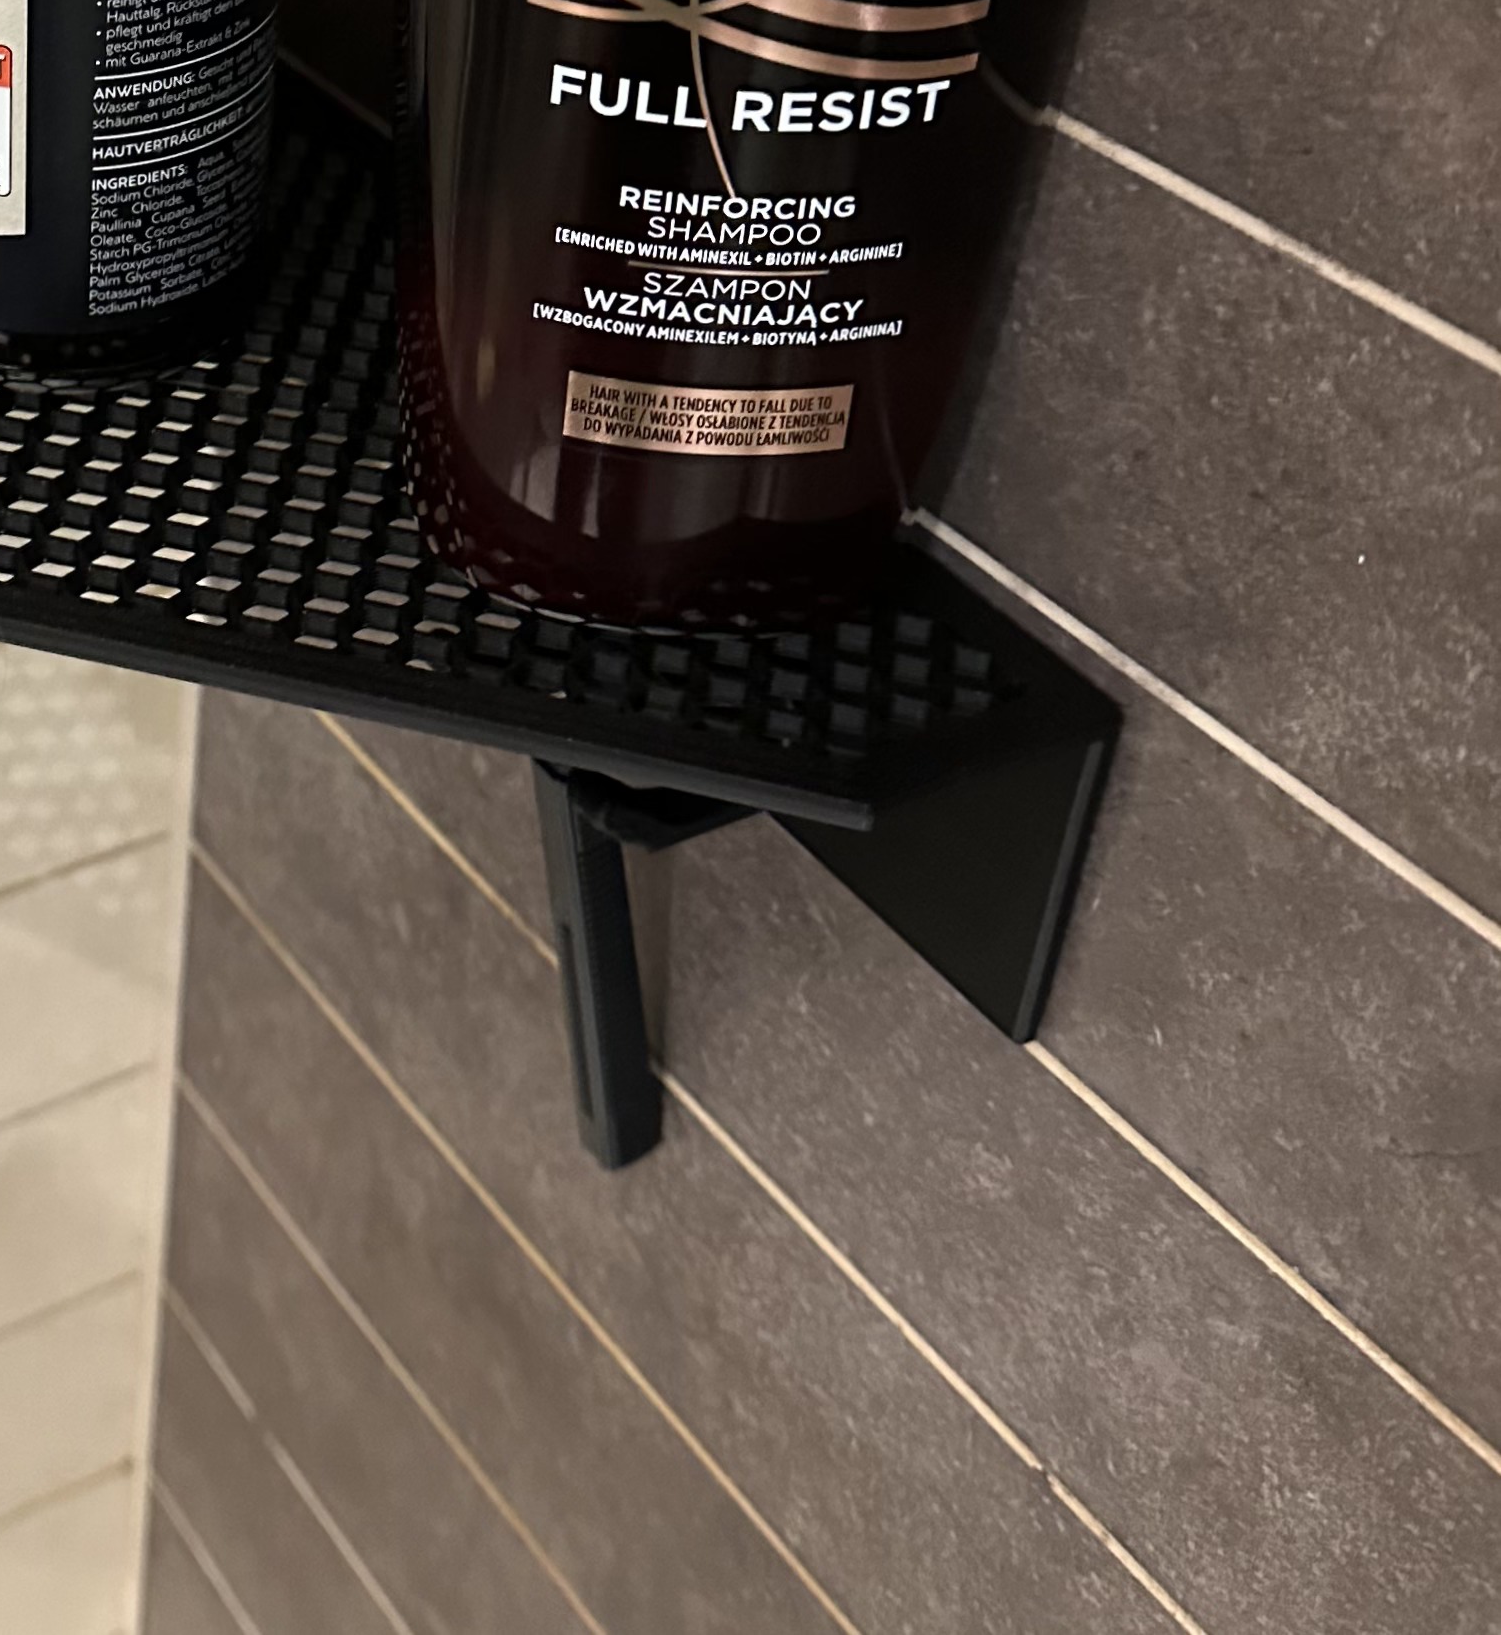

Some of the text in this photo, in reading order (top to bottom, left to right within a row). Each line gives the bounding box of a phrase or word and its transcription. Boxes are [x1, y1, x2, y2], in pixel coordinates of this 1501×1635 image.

[106, 23, 143, 41] pflegt
[146, 17, 171, 33] und
[174, 7, 212, 27] kräftigt
[214, 0, 233, 15] den
[105, 31, 183, 56] geschmeidig
[105, 54, 127, 68] mit
[93, 71, 196, 101] ANWENDUNG:
[549, 64, 951, 134] FULL RESIST
[92, 110, 158, 130] schäumen
[161, 103, 185, 119] und
[93, 100, 140, 115] Wasser
[91, 164, 188, 192] INGREDIENTS:
[91, 190, 141, 206] Sodium
[91, 206, 119, 220] Zinc
[619, 185, 856, 220] REINFORCING
[90, 218, 142, 234] Paullinia
[151, 204, 196, 225] Cupana
[647, 216, 822, 246] SHAMPOO
[90, 246, 130, 262] Starch
[133, 223, 214, 256] PG-Trimonium
[555, 227, 635, 255] [ENRICHED
[637, 242, 678, 261] WITH
[678, 248, 752, 266] AMINEXIL
[765, 250, 817, 266] BIOTIN
[829, 241, 904, 264] ARGININE]
[89, 274, 121, 288] Palm
[125, 259, 186, 285] Glycerides
[643, 272, 811, 302] SZAMPON
[89, 283, 152, 302] Potassium
[583, 286, 864, 329] WZMACNIAJĄCY
[88, 300, 138, 316] Sodium
[533, 302, 646, 338] [WZBOGACONY
[646, 325, 739, 346] AMINEXILEM
[752, 330, 817, 347] BIOTYNĄ
[571, 398, 636, 423] BREAKAGE
[649, 410, 694, 428] WŁOSY
[696, 414, 767, 430] OSŁABIONE
[768, 415, 777, 430] Z
[589, 384, 833, 414] HAIR WITH A TENDENCY TO FALL DUE TO
[583, 417, 830, 446] DO WYPADANIA Z POWODU ŁAMLIWOŚCI
